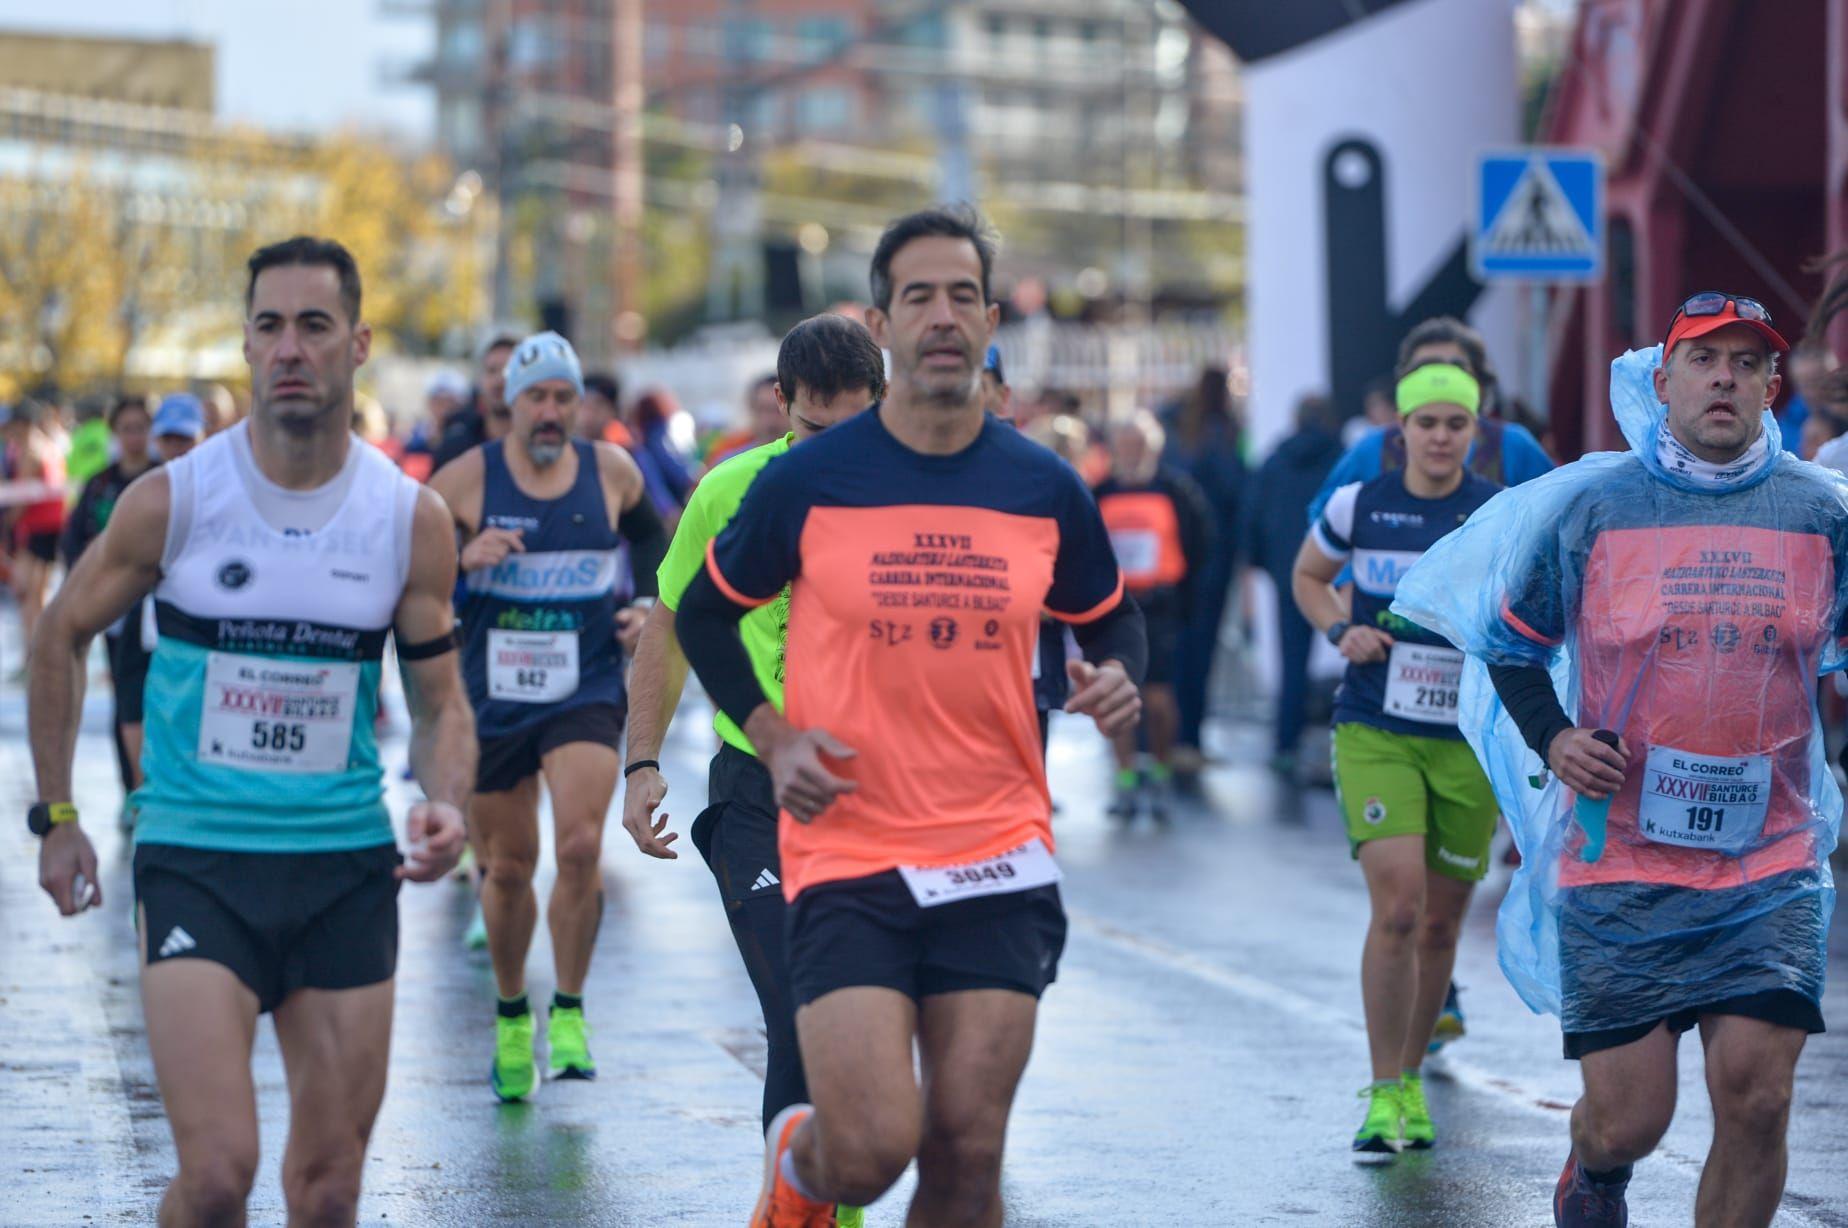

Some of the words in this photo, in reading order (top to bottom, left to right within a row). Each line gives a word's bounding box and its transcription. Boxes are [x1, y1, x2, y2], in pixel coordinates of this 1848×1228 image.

[869, 571, 921, 585] CARRERA
[925, 572, 1011, 591] INTERNACIONAL
[1660, 583, 1706, 596] CARRERA
[1709, 583, 1786, 601] INTERNACIONAL
[1698, 601, 1742, 616] SANTURCE
[1415, 685, 1459, 709] 2139
[252, 720, 306, 752] 585
[1673, 759, 1688, 771] EL
[1690, 763, 1744, 776] CORREO
[1655, 774, 1709, 801] XXXVII
[1709, 784, 1759, 793] SANTURCE
[1708, 792, 1758, 803] BILBAO
[1685, 806, 1725, 832] 191
[1659, 827, 1716, 843] kutxabank
